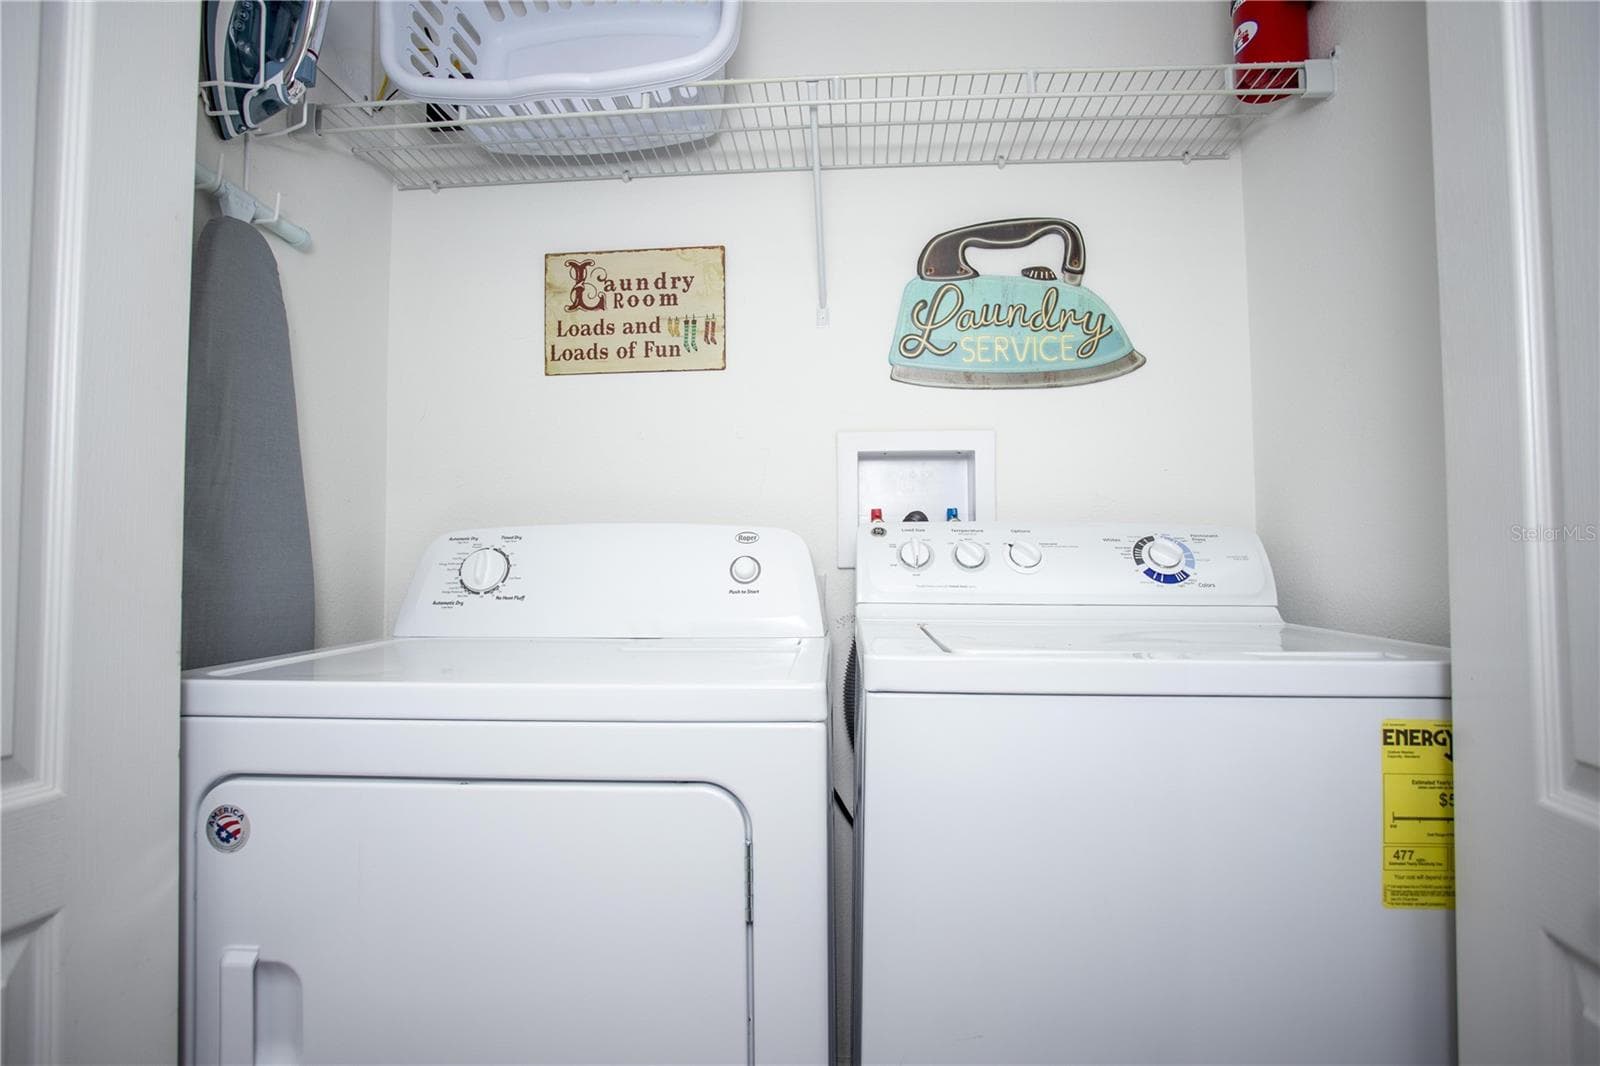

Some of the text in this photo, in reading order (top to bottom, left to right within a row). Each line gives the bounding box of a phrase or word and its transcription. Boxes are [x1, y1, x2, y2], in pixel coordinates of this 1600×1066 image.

[564, 259, 695, 312] Laundry
[613, 292, 679, 309] Room
[556, 316, 662, 338] Loads and
[899, 283, 1113, 359] Laundry
[550, 341, 681, 362] Loads of Fun
[960, 334, 1076, 363] SERVICE
[738, 534, 757, 542] Roper
[1393, 849, 1414, 861] 477
